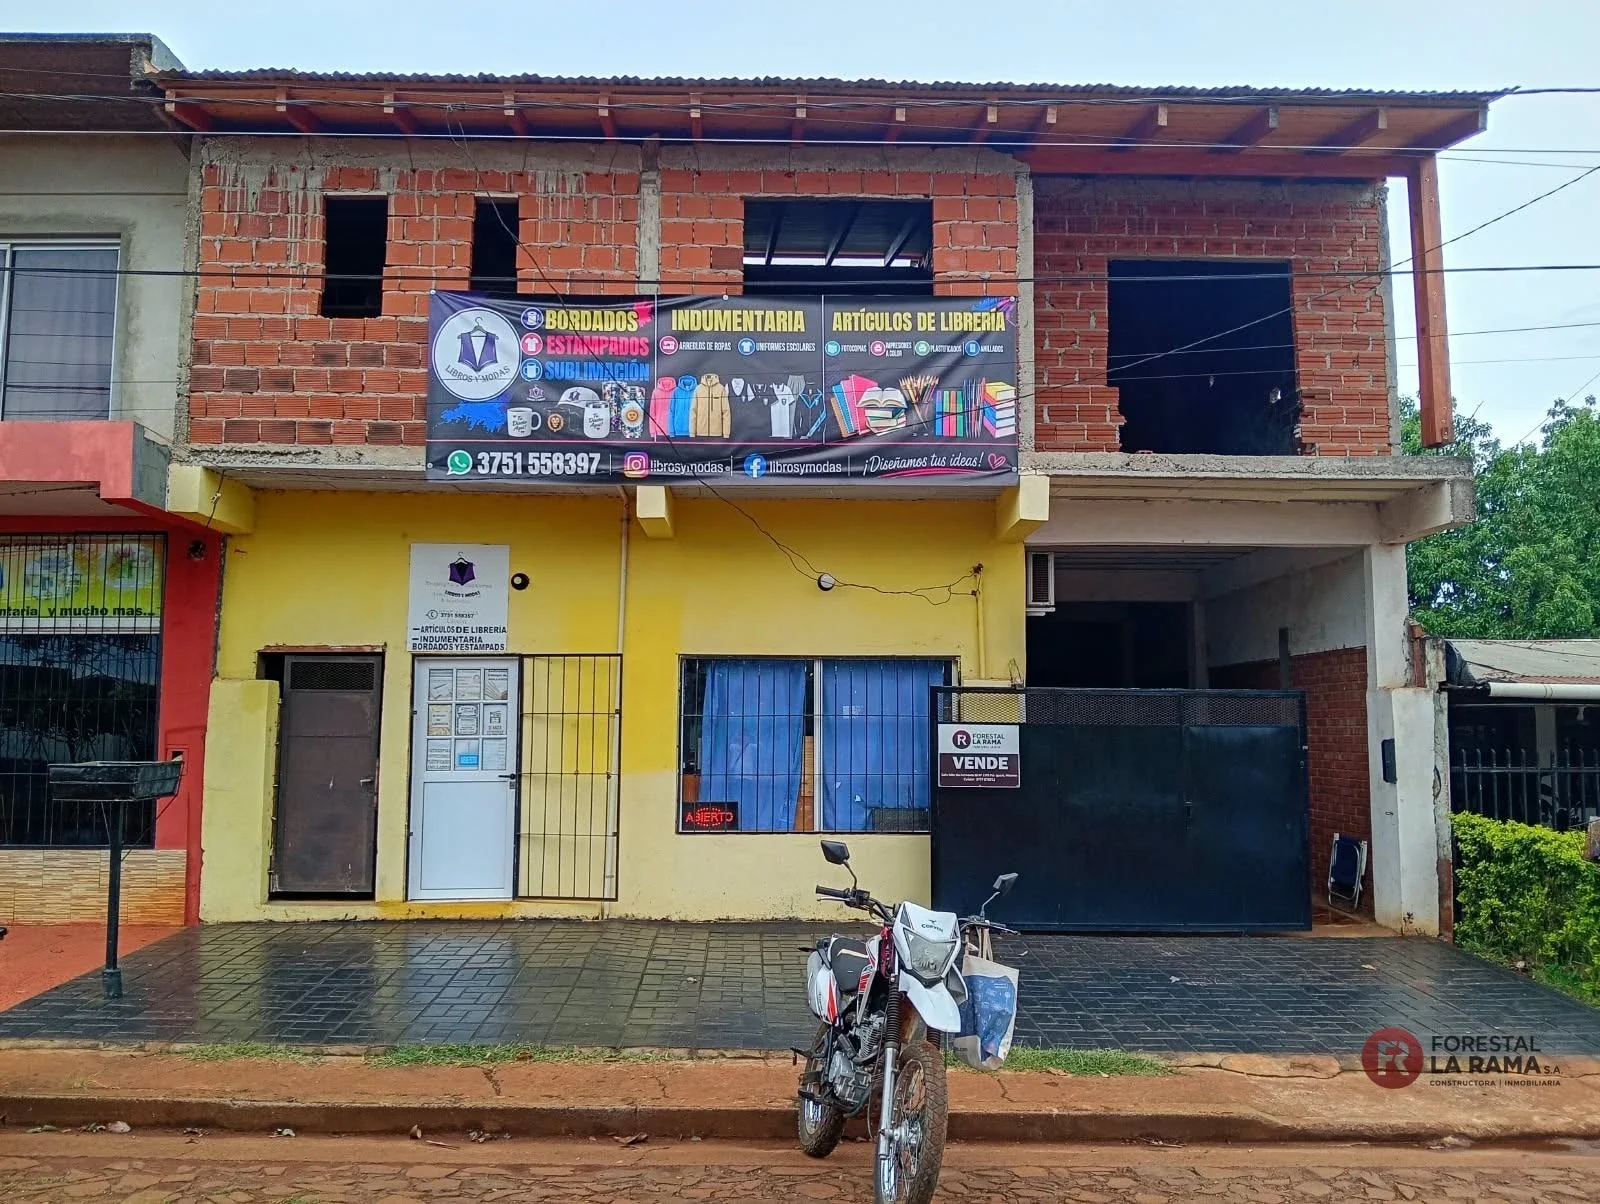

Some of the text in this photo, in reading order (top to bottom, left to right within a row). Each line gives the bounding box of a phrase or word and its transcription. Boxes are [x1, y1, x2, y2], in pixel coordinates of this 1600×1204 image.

[545, 309, 639, 332] BORDADOS
[671, 309, 806, 332] INDUMENTARIA
[832, 308, 1006, 332] ARTÍCULOS DE LIBRERÍA
[546, 335, 650, 356] ESTAMPADOS
[680, 341, 732, 352] ARREGLOS DE ROPAS
[755, 342, 816, 352] UNIFORMES ESCOLARES
[445, 364, 473, 383] LIBROS
[481, 365, 511, 383] MODAS
[544, 358, 650, 381] SUBLIMACIÓN
[477, 452, 601, 475] 3751 558397
[650, 459, 724, 475] librosymodas
[769, 460, 842, 476] librosymodas
[863, 451, 985, 476] ¡Diseñamos tus ideas!
[60, 605, 108, 616] mucho
[455, 626, 470, 634] DE
[412, 643, 454, 651] BORDADOS
[952, 756, 1009, 770] VENDE
[685, 812, 734, 823] ABIERTO
